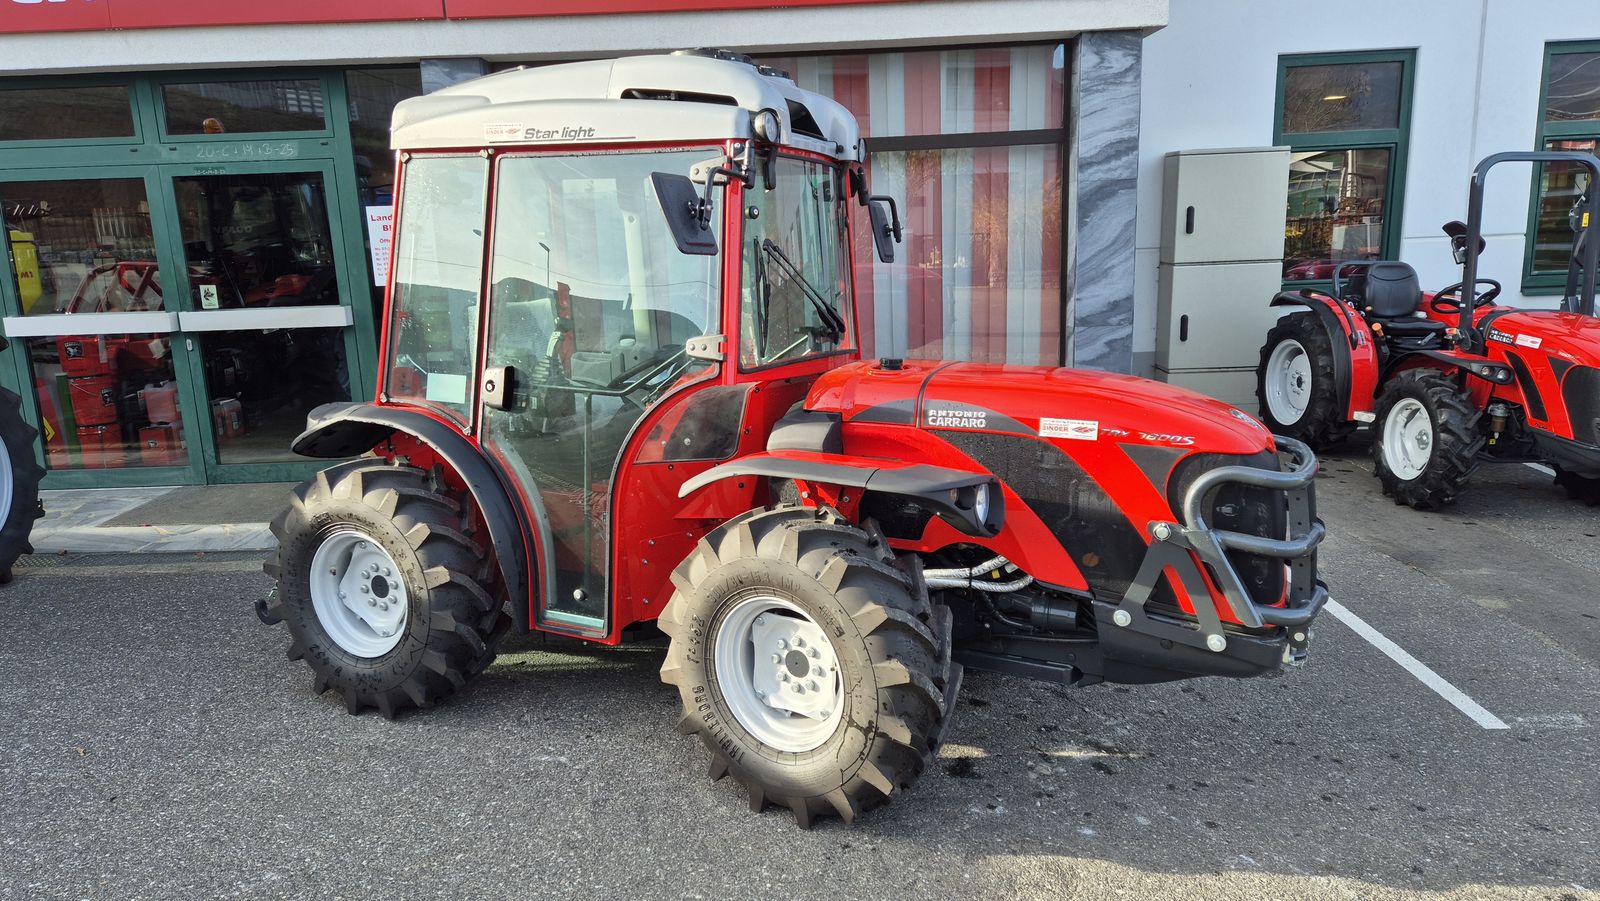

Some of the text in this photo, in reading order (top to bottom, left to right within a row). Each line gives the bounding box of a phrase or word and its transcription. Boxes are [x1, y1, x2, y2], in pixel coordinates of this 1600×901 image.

[928, 409, 986, 418] ANTONIO
[928, 416, 987, 428] CARRARO
[692, 685, 746, 766] TRELLEBORG
